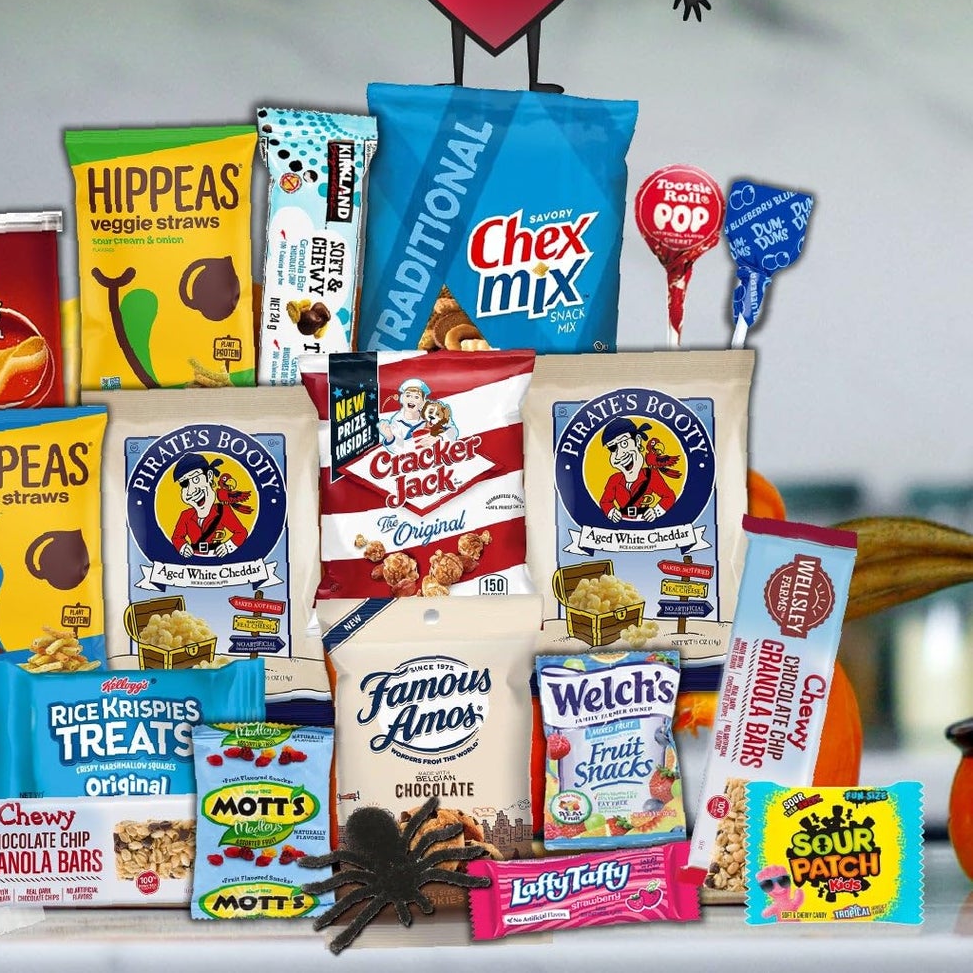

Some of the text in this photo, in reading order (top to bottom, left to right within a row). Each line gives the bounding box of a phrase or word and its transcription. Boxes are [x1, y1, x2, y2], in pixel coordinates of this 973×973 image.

[88, 163, 239, 213] HIPPEAS
[338, 145, 351, 219] KIRKLAND
[657, 180, 712, 194] Tootsie
[91, 215, 220, 233] veggie straws
[530, 209, 573, 223] SAVORY
[653, 204, 709, 233] POP
[731, 201, 773, 231] BLUEBERRY
[368, 121, 493, 352] TRADITIONAL
[470, 216, 590, 269] Chex
[754, 229, 789, 250] DUMS
[297, 239, 308, 292] Granola Bar
[309, 237, 327, 296] CHEWY
[327, 241, 345, 292] SOFT &
[551, 308, 584, 321] SNACK
[558, 322, 576, 333] MIX
[216, 349, 239, 358] PROTEIN
[335, 392, 366, 423] NEW
[338, 415, 367, 441] PRIZE
[561, 393, 708, 456] PIRATE'S BOOTY
[336, 429, 372, 460] INSIDE!
[369, 435, 481, 479] Cracker
[133, 429, 279, 492] PIRATE'S BOOTY
[2, 490, 69, 506] straws
[386, 466, 456, 509] Jack
[377, 510, 466, 546] The Original
[586, 528, 689, 545] Aged White Cheddar
[157, 565, 261, 580] Aged White Cheddar
[484, 579, 504, 592] 150
[777, 575, 792, 612] FARMS
[786, 560, 815, 634] WELLSLEY
[344, 614, 362, 632] NEW
[410, 664, 434, 672] SINCE
[101, 678, 149, 694] Kellogg's
[357, 668, 492, 725] Famous
[547, 671, 674, 717] Welch's
[51, 697, 200, 727] RICE KRISPIES
[740, 639, 785, 768] GRANOLA BARS
[767, 656, 800, 760] CHOCOLATE CHIP
[788, 675, 826, 751] Chewy
[56, 721, 193, 760] TREATS
[370, 703, 483, 753] Amos
[391, 741, 479, 765] WONDERS FROM THE WORLD
[590, 737, 645, 765] Fruit
[86, 775, 169, 796] Original
[574, 757, 654, 787] Snacks
[395, 783, 474, 798] CHOCOLATE
[783, 792, 806, 809] SOUR
[211, 797, 305, 816] MOTT'S
[62, 832, 89, 848] CHIP
[235, 822, 282, 836] Medleys
[793, 828, 874, 856] SOUR
[59, 849, 102, 873] BARS
[791, 852, 879, 881] PATCH
[510, 862, 630, 906] Laffy Taffy
[828, 878, 862, 892] Kids
[212, 895, 305, 911] MOTT'S
[571, 892, 621, 911] strawberry
[834, 906, 871, 920] TROPICAL
